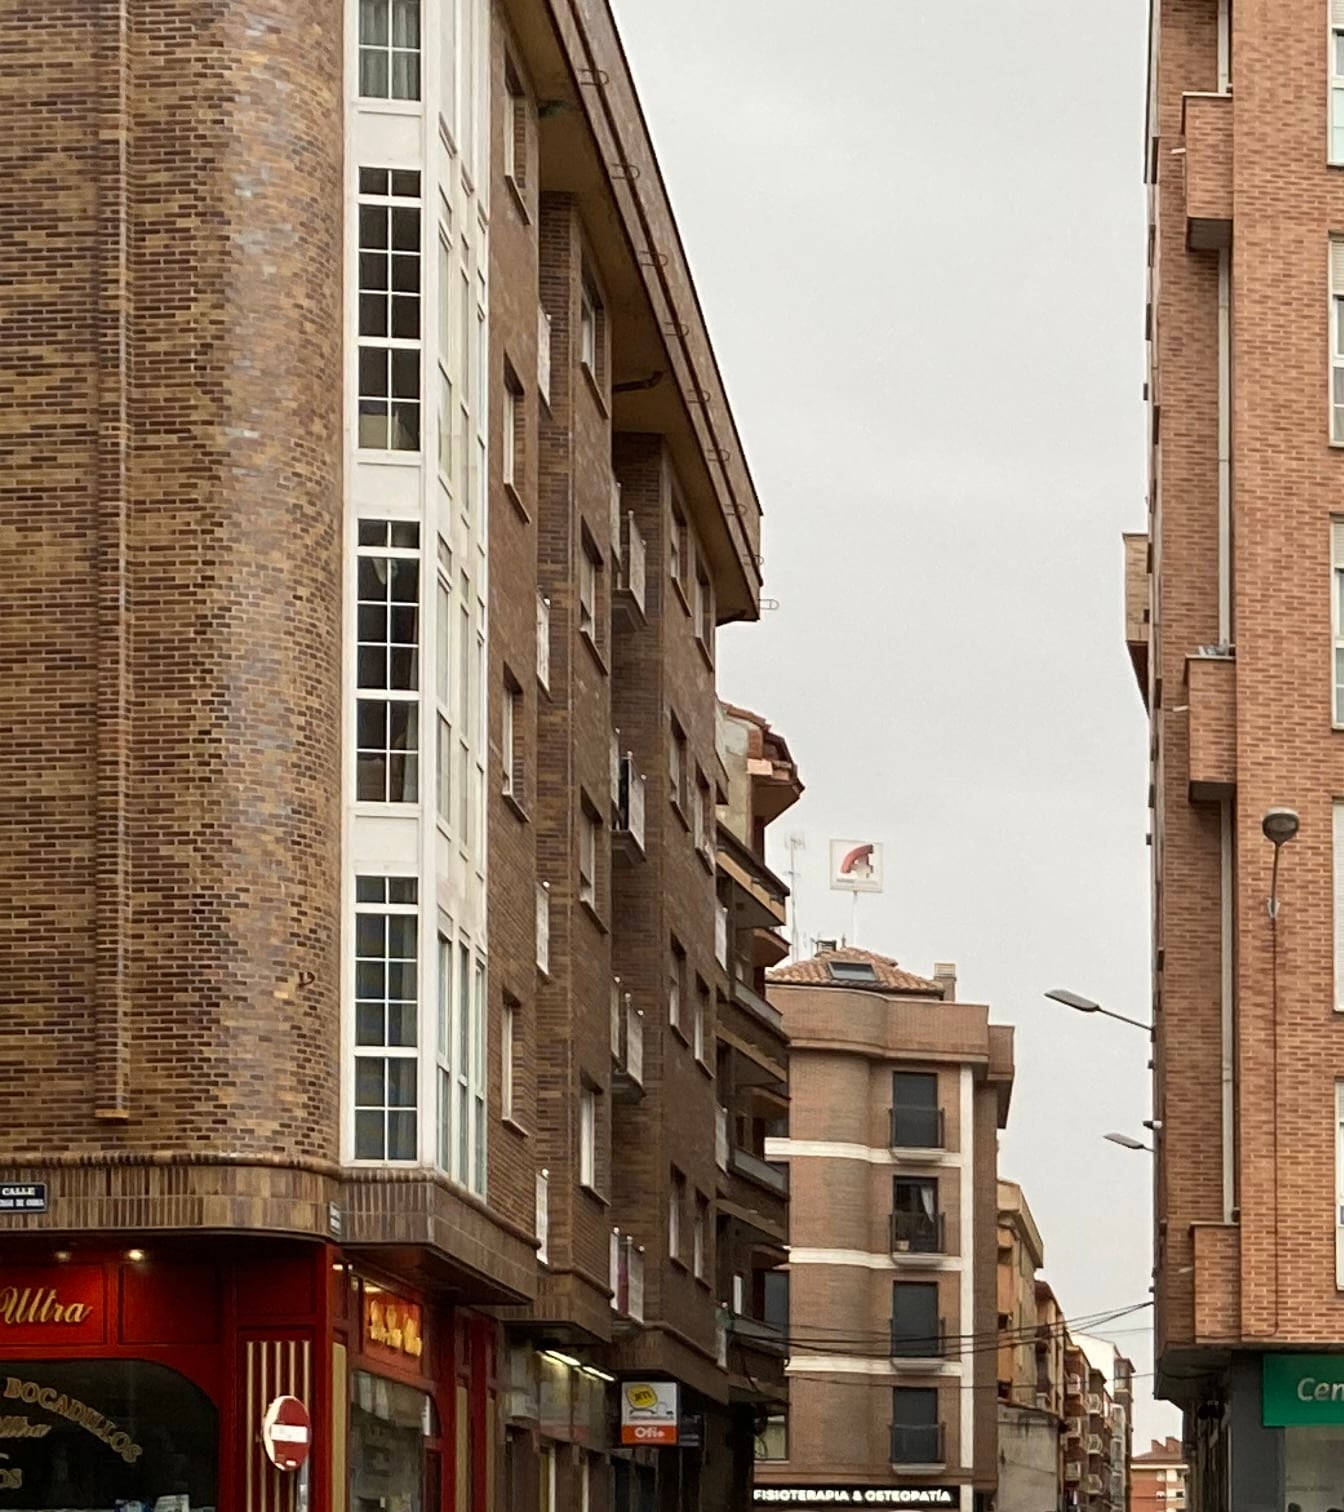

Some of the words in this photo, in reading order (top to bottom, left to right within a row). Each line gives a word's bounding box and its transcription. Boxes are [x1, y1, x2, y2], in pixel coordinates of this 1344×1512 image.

[2, 1187, 35, 1196] CALLE
[753, 1489, 849, 1501] FISIOTERAPIA
[852, 1490, 862, 1501] &
[864, 1488, 951, 1501] OSTEOPATÍA
